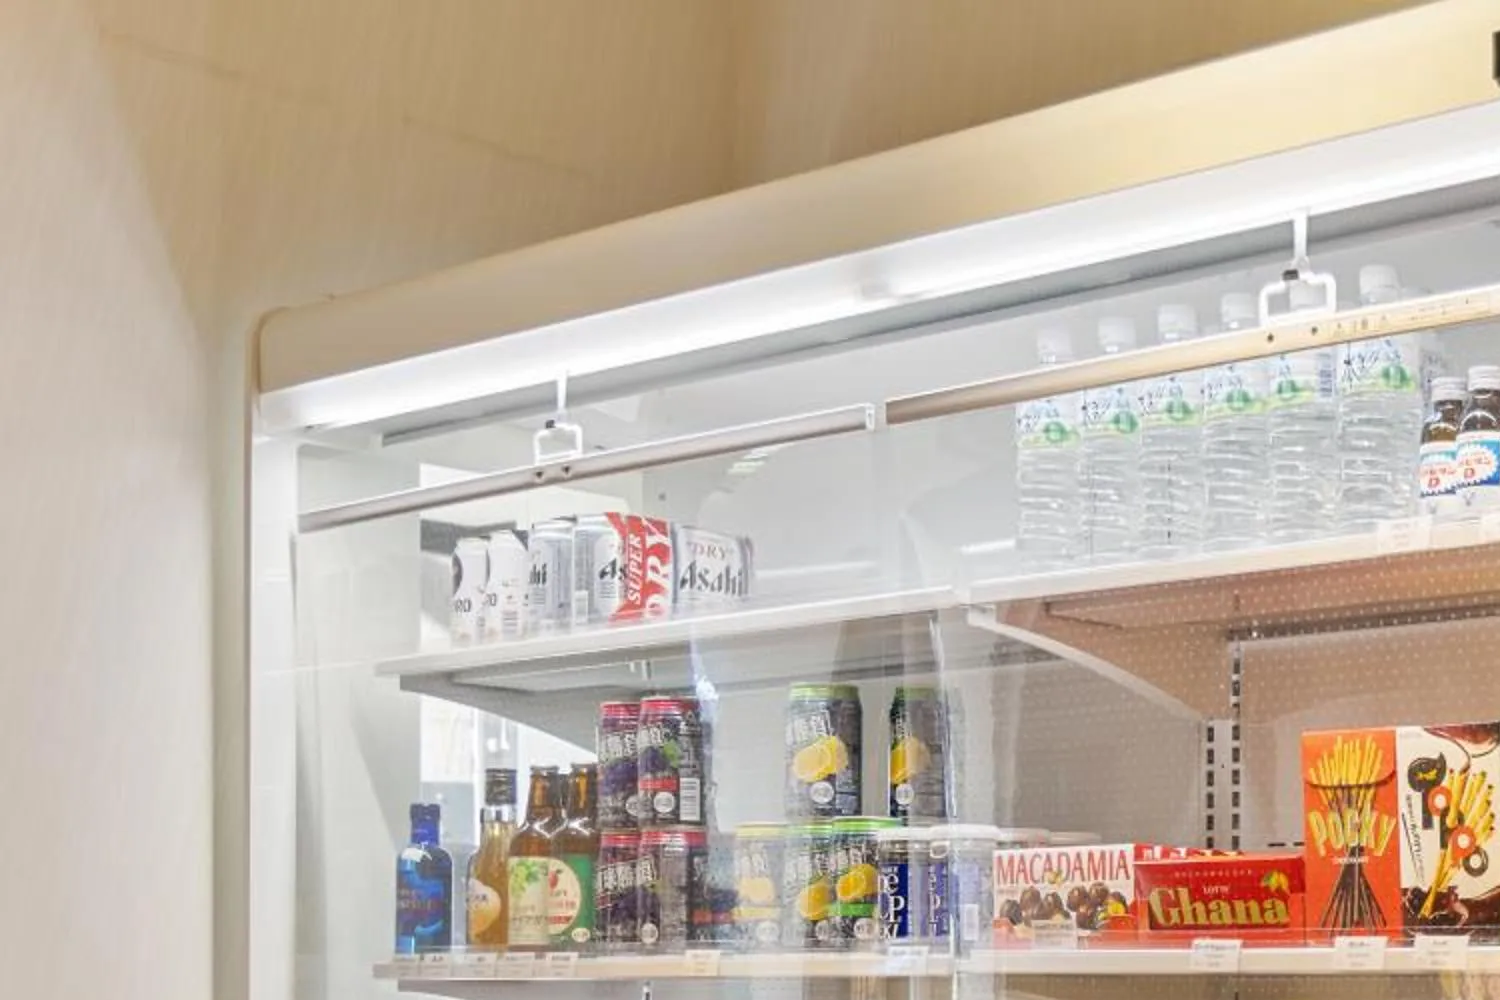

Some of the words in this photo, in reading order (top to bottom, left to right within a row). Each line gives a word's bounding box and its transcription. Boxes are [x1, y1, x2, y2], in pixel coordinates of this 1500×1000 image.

[626, 532, 645, 605] SUPER
[679, 557, 750, 598] Asahi
[1307, 805, 1398, 858] POCKY
[996, 848, 1131, 886] MACADAMIA
[1149, 886, 1291, 927] Ghana
